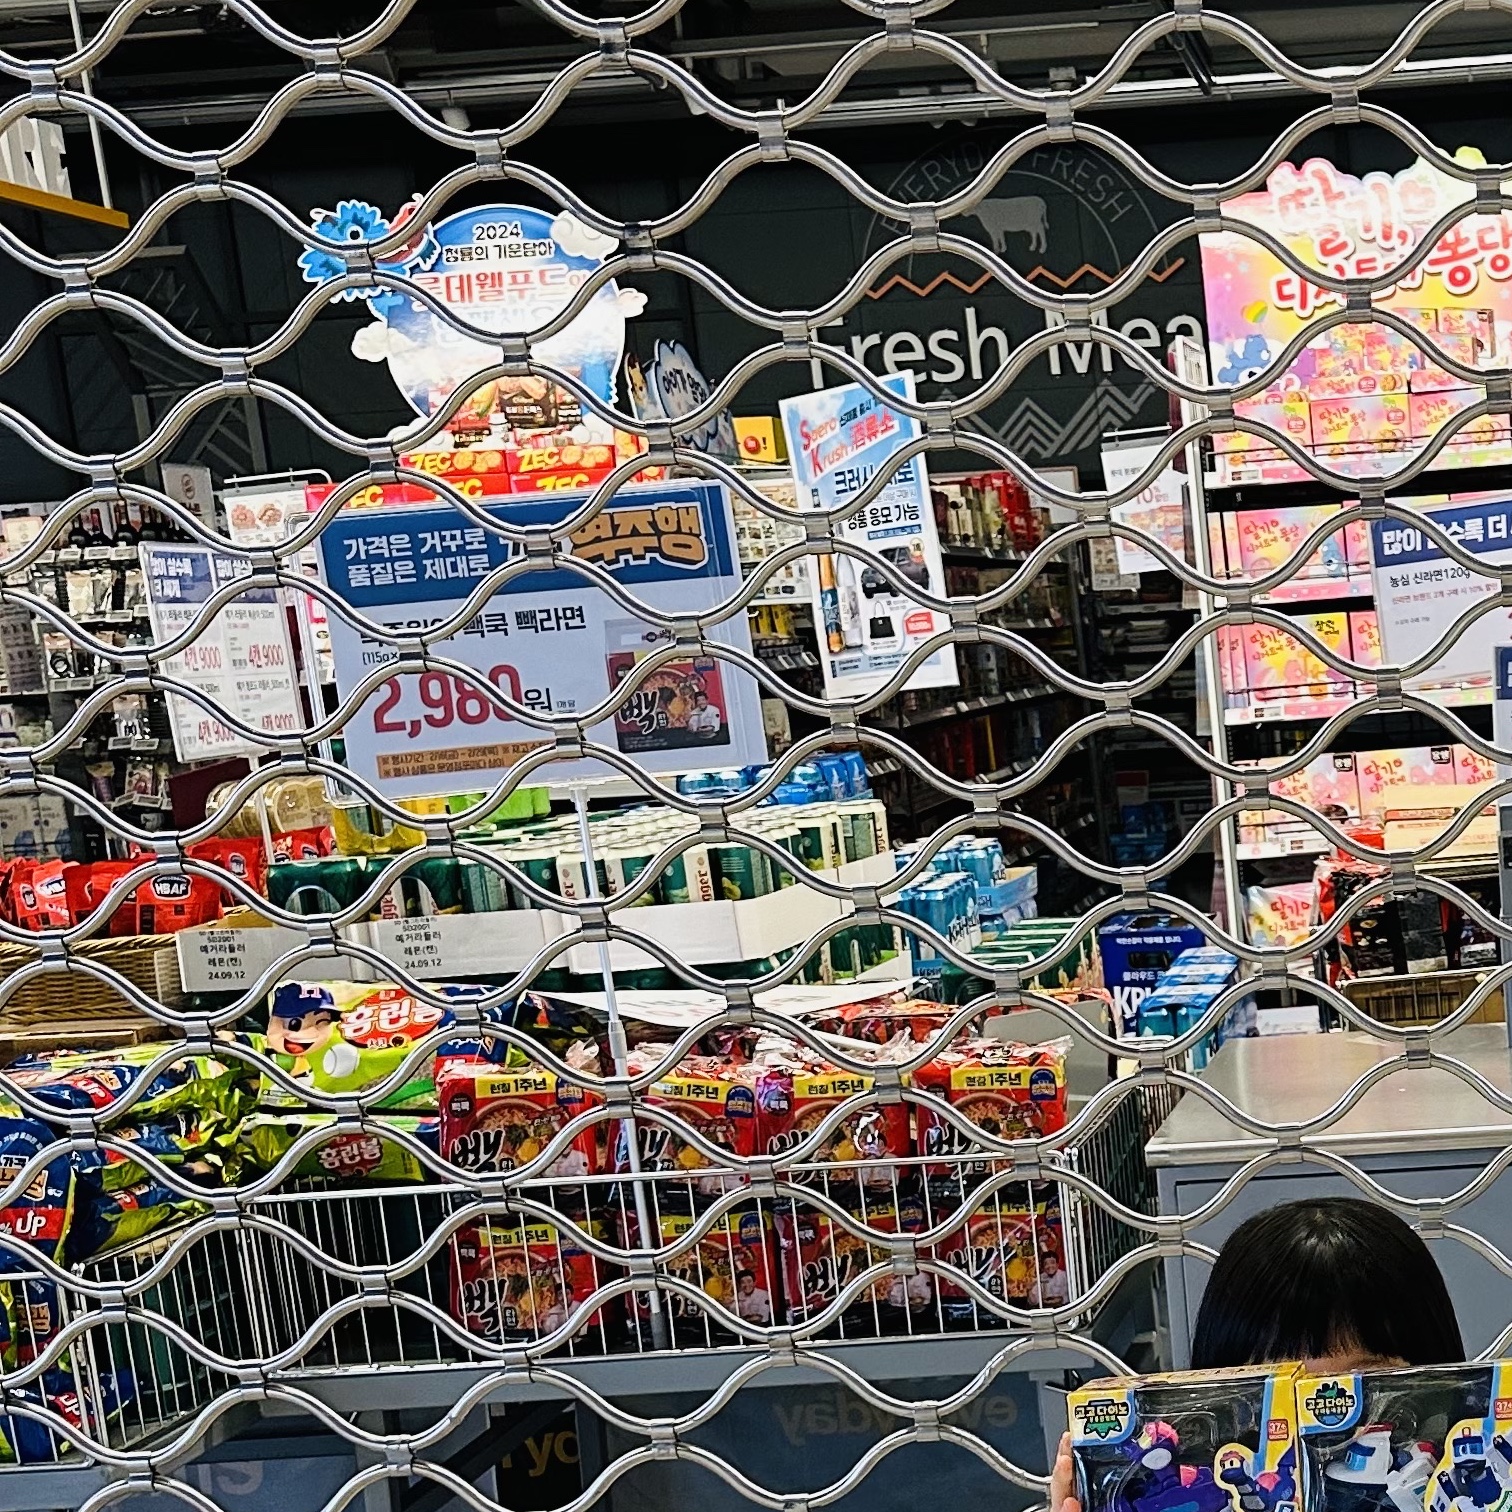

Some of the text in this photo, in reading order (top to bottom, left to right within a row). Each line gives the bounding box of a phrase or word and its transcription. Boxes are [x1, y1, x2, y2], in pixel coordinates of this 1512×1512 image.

[475, 224, 521, 241] 2024
[807, 306, 1204, 390] Fresh Mea
[517, 446, 560, 473] ZEC
[870, 507, 894, 527] 응모
[344, 531, 412, 561] 가격은
[419, 527, 488, 553] 거꾸로
[1382, 527, 1421, 557] 많이
[1488, 514, 1507, 539] 더
[348, 554, 493, 588] 품질은 제대로
[1390, 573, 1411, 589] 농심
[404, 958, 443, 969] 24.09.12
[208, 971, 246, 980] 24.09.12
[513, 1078, 549, 1093] 1주년
[830, 1079, 866, 1094] 1주년
[988, 1072, 1022, 1086] 1주년
[686, 1084, 720, 1099] 1주년
[16, 1210, 47, 1237] UP
[1075, 1404, 1130, 1421] 고고다이노
